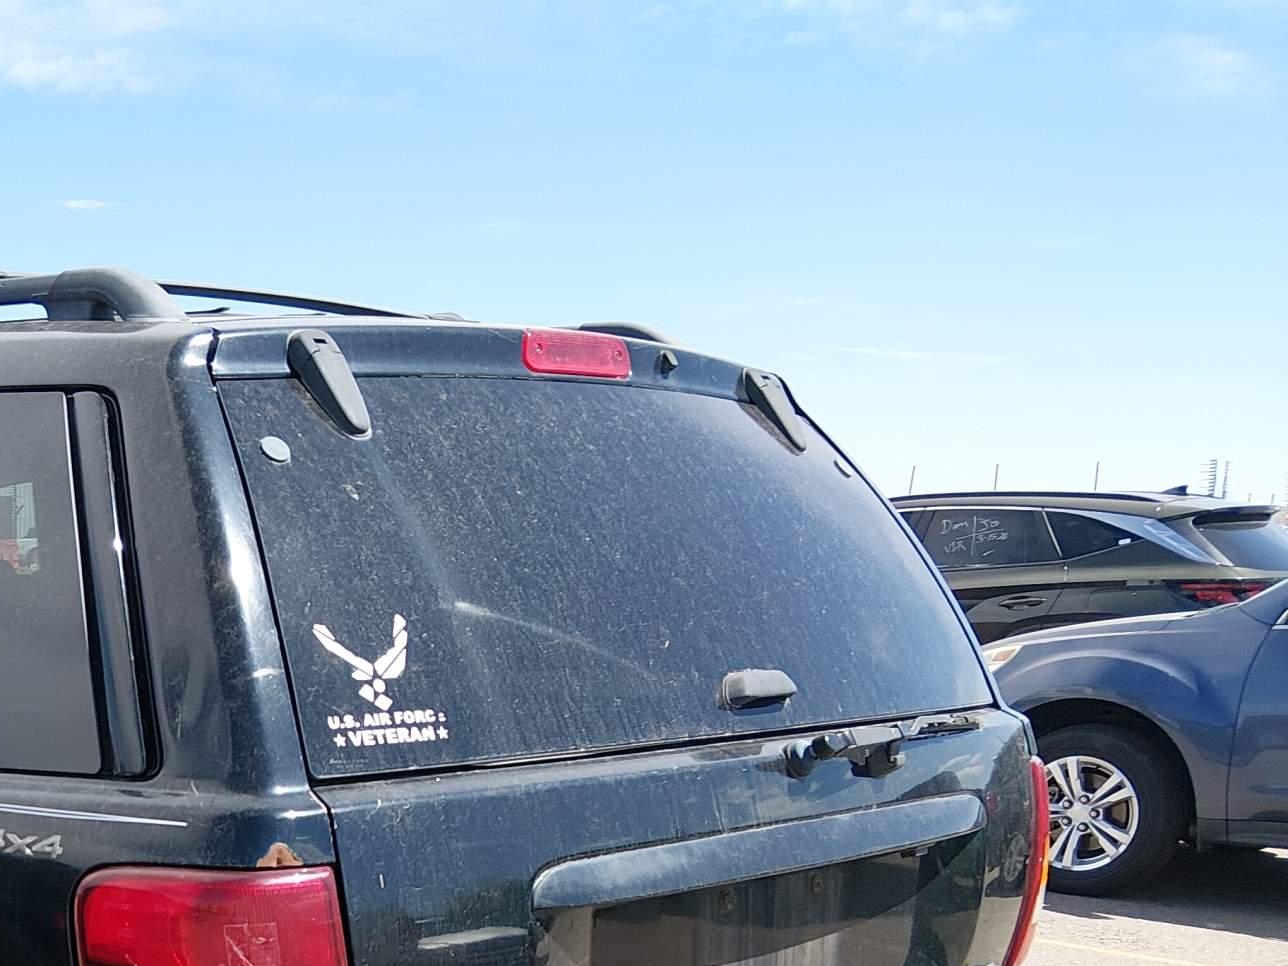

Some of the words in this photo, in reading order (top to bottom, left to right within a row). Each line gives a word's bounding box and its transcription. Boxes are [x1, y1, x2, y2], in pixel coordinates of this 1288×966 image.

[327, 714, 361, 730] U.S.
[363, 712, 393, 727] AIR
[347, 725, 436, 747] VETERAN
